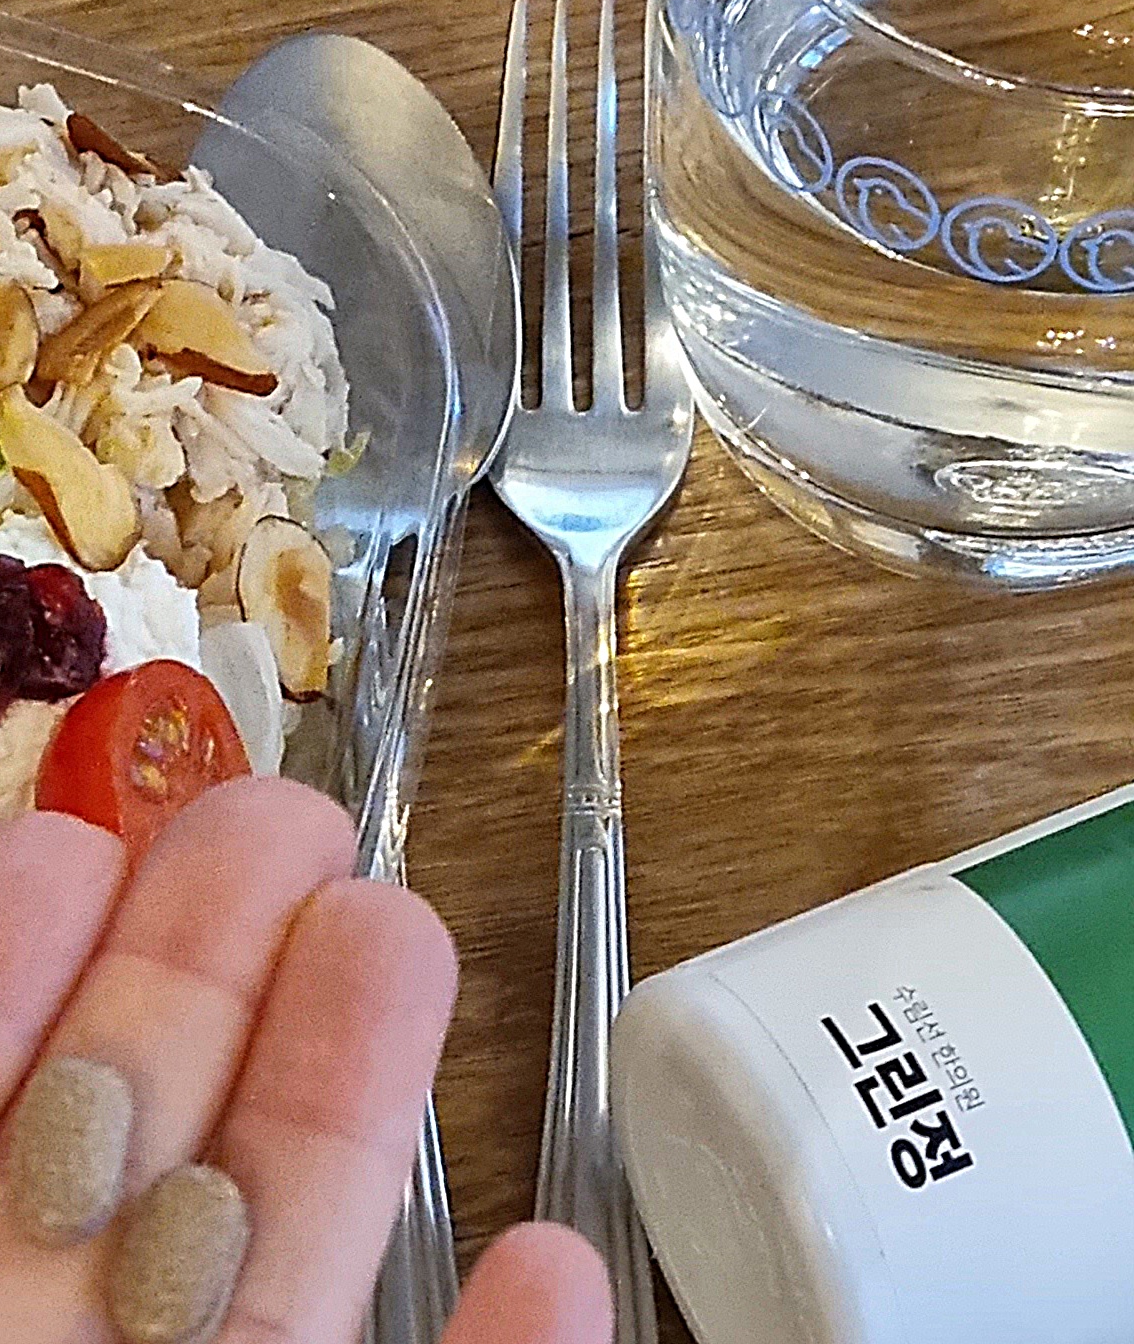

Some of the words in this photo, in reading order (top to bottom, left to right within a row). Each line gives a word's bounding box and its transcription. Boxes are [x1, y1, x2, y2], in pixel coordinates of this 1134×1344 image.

[820, 1002, 974, 1190] 그린정
[893, 985, 946, 1044] 수림선
[931, 1043, 985, 1112] 한의원
